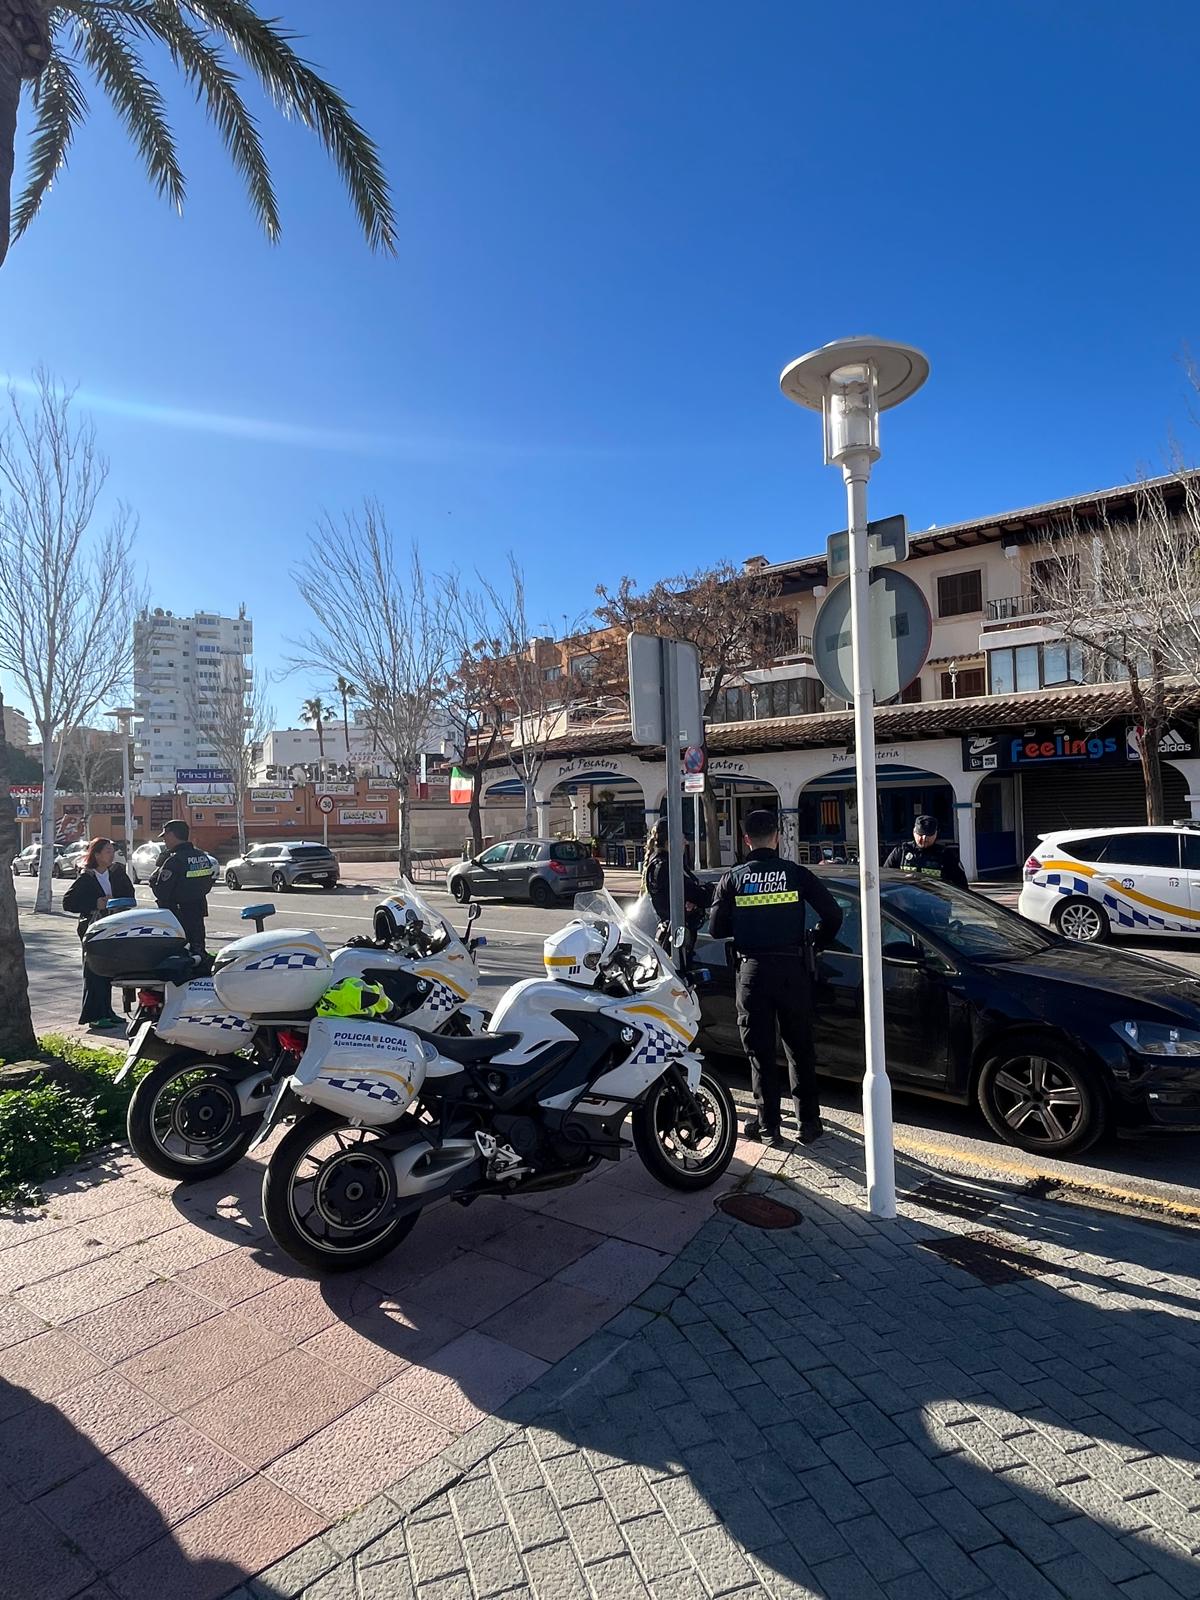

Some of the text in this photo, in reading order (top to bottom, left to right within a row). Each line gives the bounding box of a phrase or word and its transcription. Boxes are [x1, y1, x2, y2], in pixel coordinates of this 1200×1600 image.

[973, 736, 993, 747] NIKE
[1157, 743, 1192, 752] didas
[559, 758, 618, 777] Dal Pescatore
[177, 771, 207, 779] Prince
[322, 800, 331, 808] 30
[742, 870, 787, 884] POLICIA
[758, 881, 788, 893] LOCAL
[1169, 879, 1180, 888] 112
[333, 1040, 375, 1048] Ajuntament
[379, 1036, 408, 1047] LOCAL
